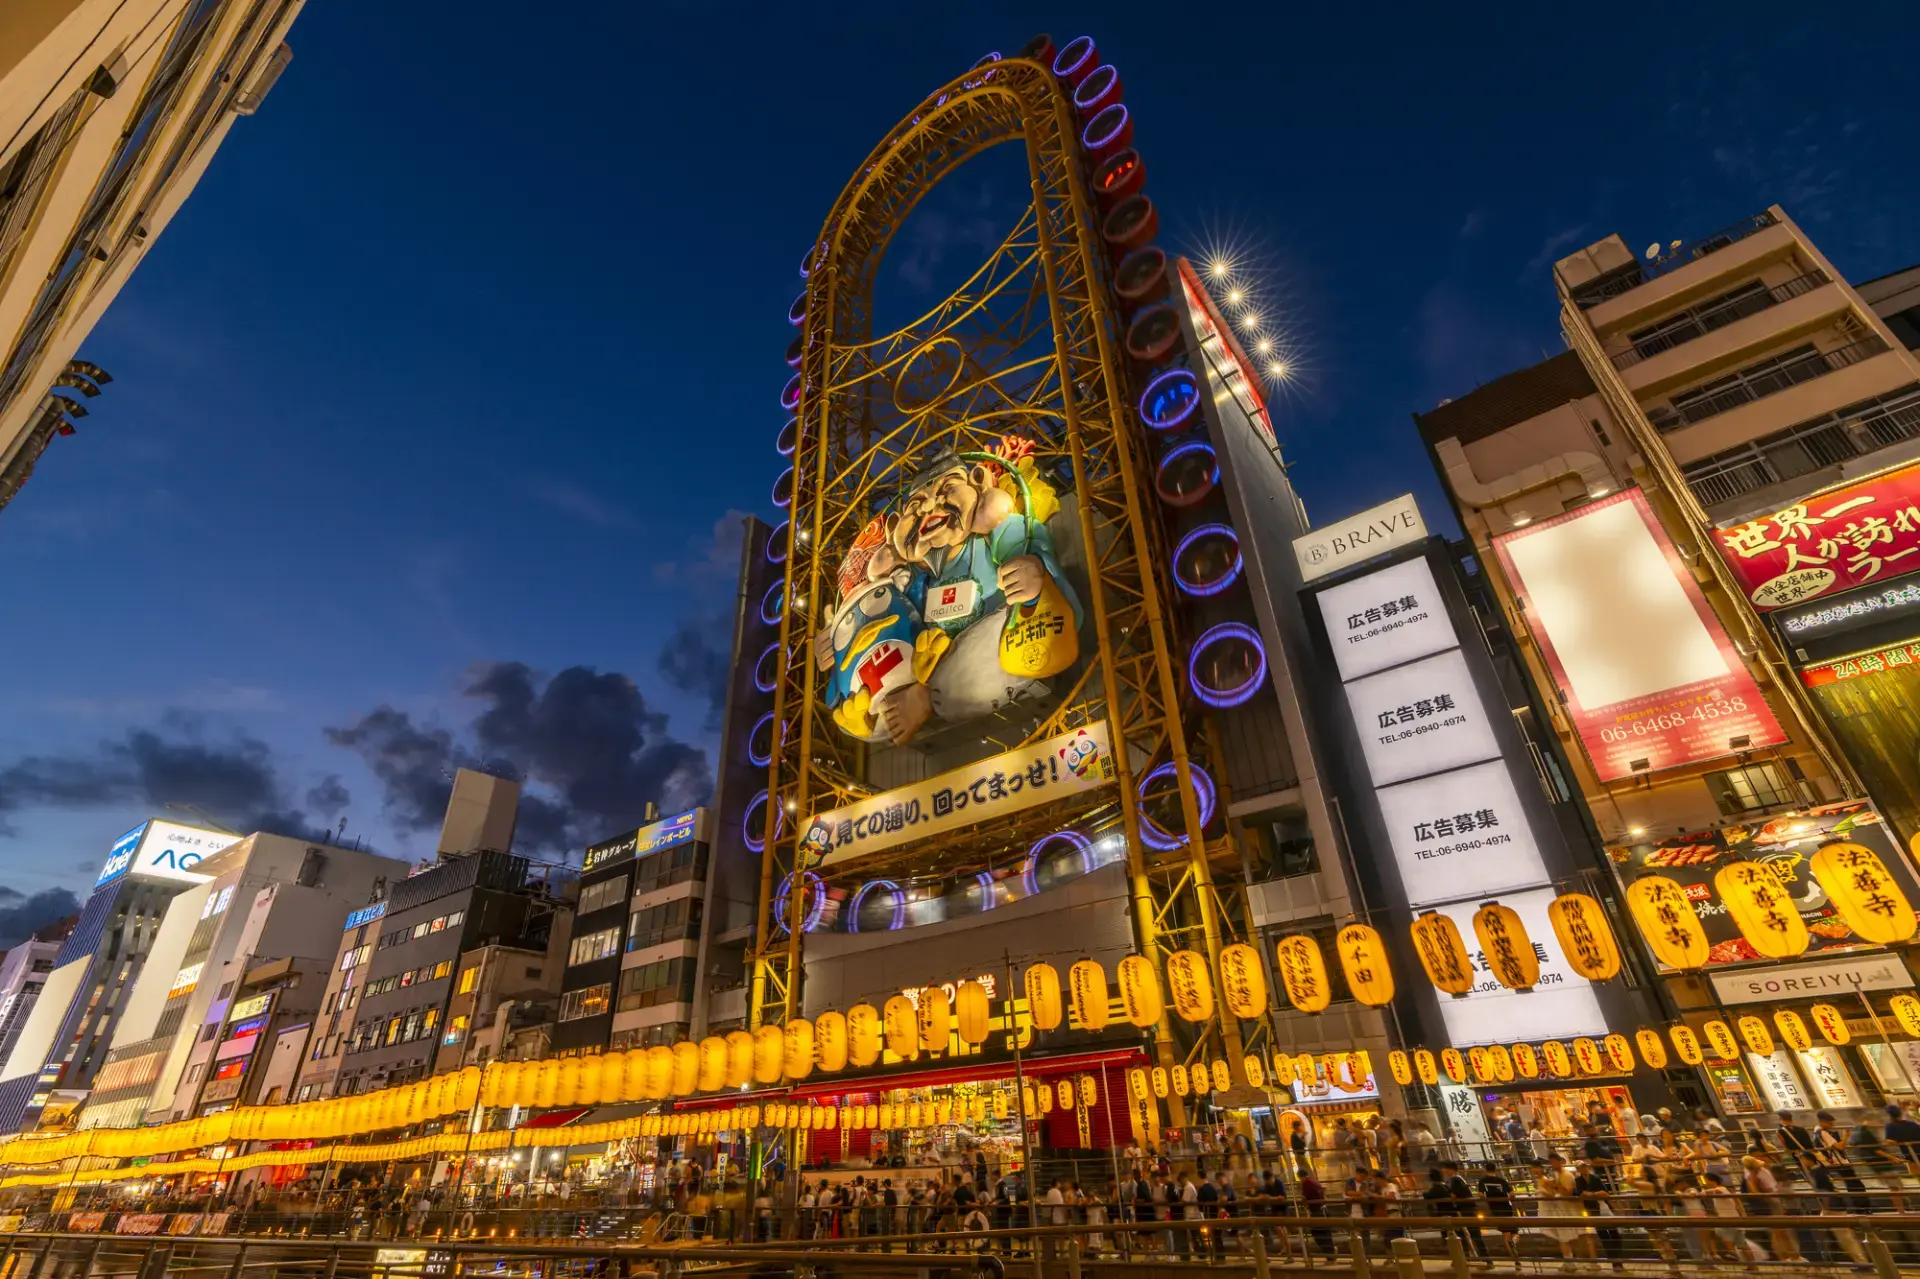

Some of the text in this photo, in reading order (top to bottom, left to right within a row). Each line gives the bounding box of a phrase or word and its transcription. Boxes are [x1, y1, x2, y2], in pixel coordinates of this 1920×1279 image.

[1332, 510, 1416, 555] BRAVE
[1724, 496, 1876, 558] 世界一
[1776, 584, 1820, 604] 世界一
[1347, 595, 1419, 629] 広告募集
[1347, 612, 1429, 644] TEL:06-6940-4974
[1378, 694, 1456, 729] 広告募集
[1600, 696, 1747, 743] 06-6468-4538
[1379, 715, 1467, 745] TEL:06-6940-4974
[1101, 756, 1113, 780] 開運
[1413, 809, 1499, 843] 広告募集
[1415, 834, 1511, 861] TEL:06-6940-4974
[1737, 867, 1789, 932] 法善寺
[1836, 850, 1897, 917] 法善寺
[1645, 883, 1693, 949] 法善寺
[1748, 972, 1863, 994] SOREIYU
[1448, 1089, 1477, 1113] 勝
